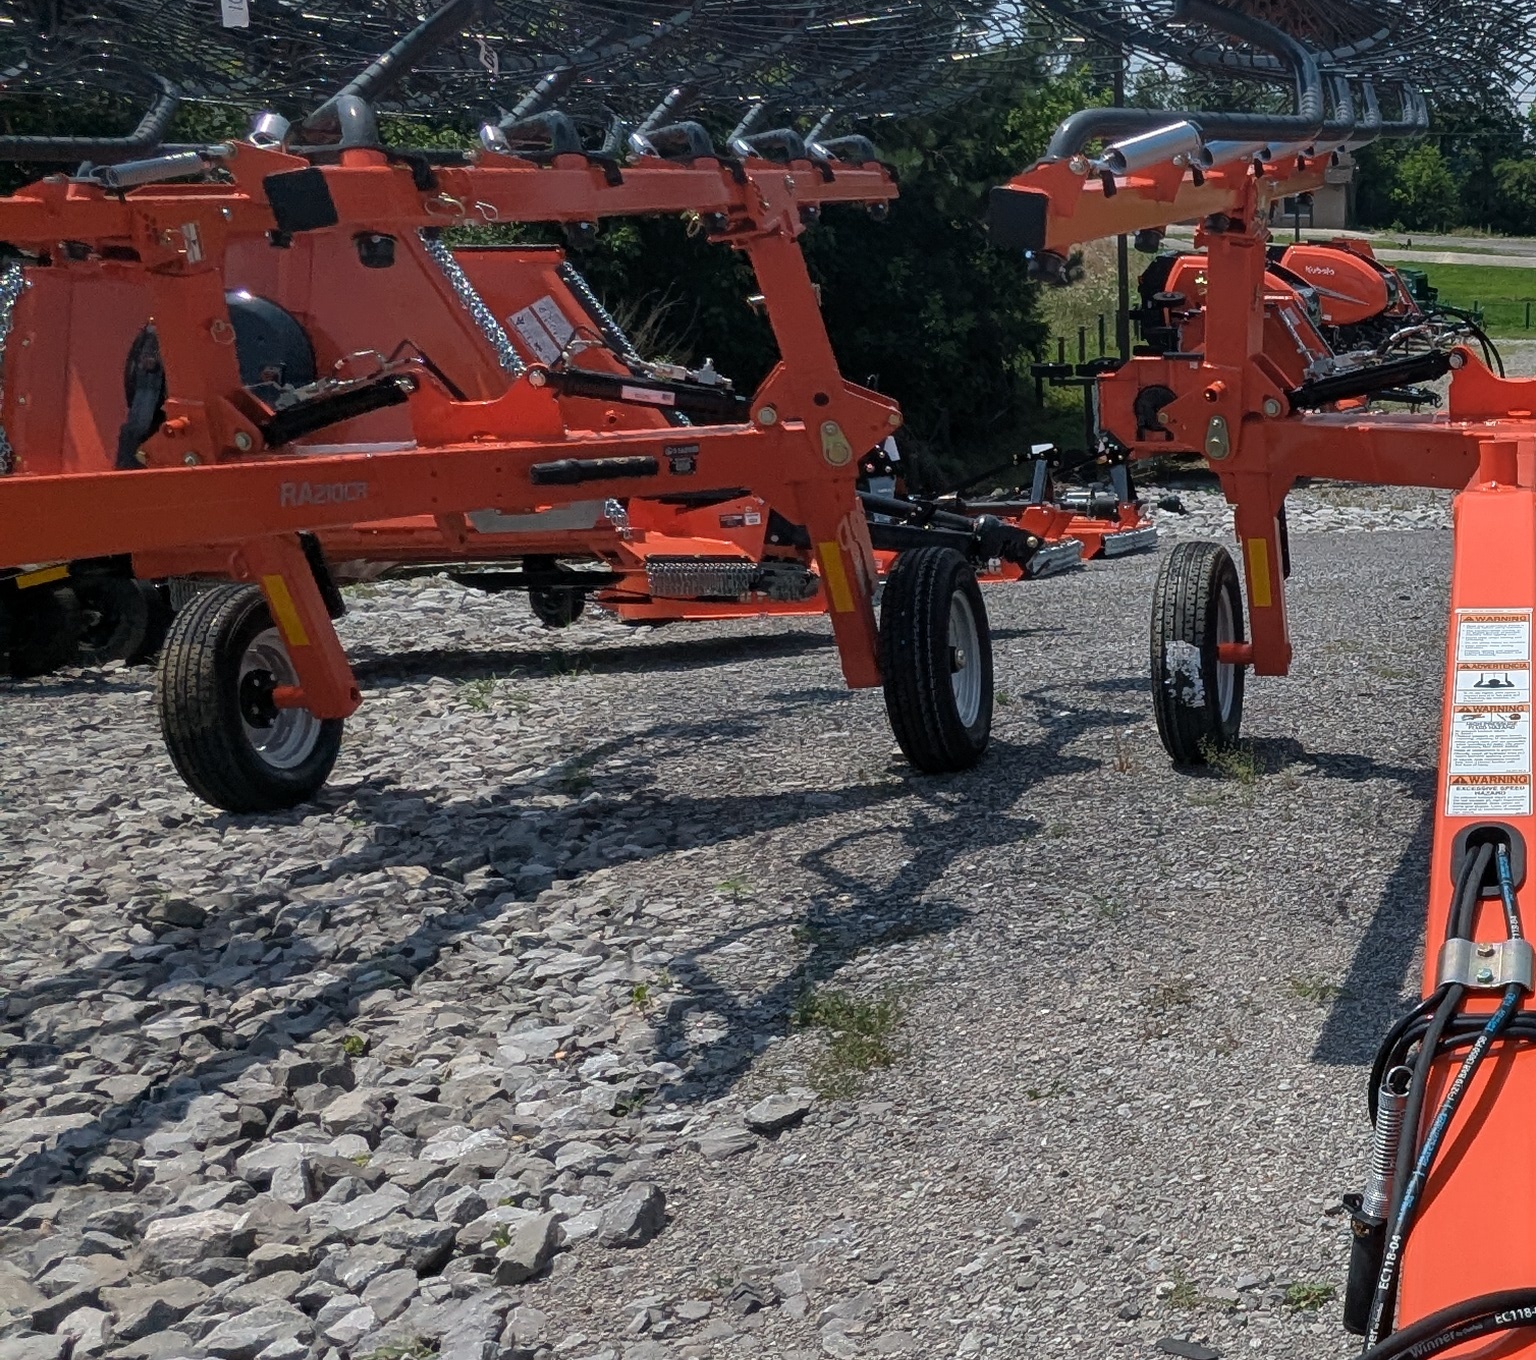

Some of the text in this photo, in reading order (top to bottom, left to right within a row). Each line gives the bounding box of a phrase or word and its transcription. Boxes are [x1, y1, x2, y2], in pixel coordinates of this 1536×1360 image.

[1305, 265, 1335, 276] Kubota
[1473, 705, 1525, 713] WARNING
[1469, 775, 1528, 784] WARNING
[1378, 1234, 1402, 1290] EC118-04
[1408, 1330, 1457, 1358] Winner
